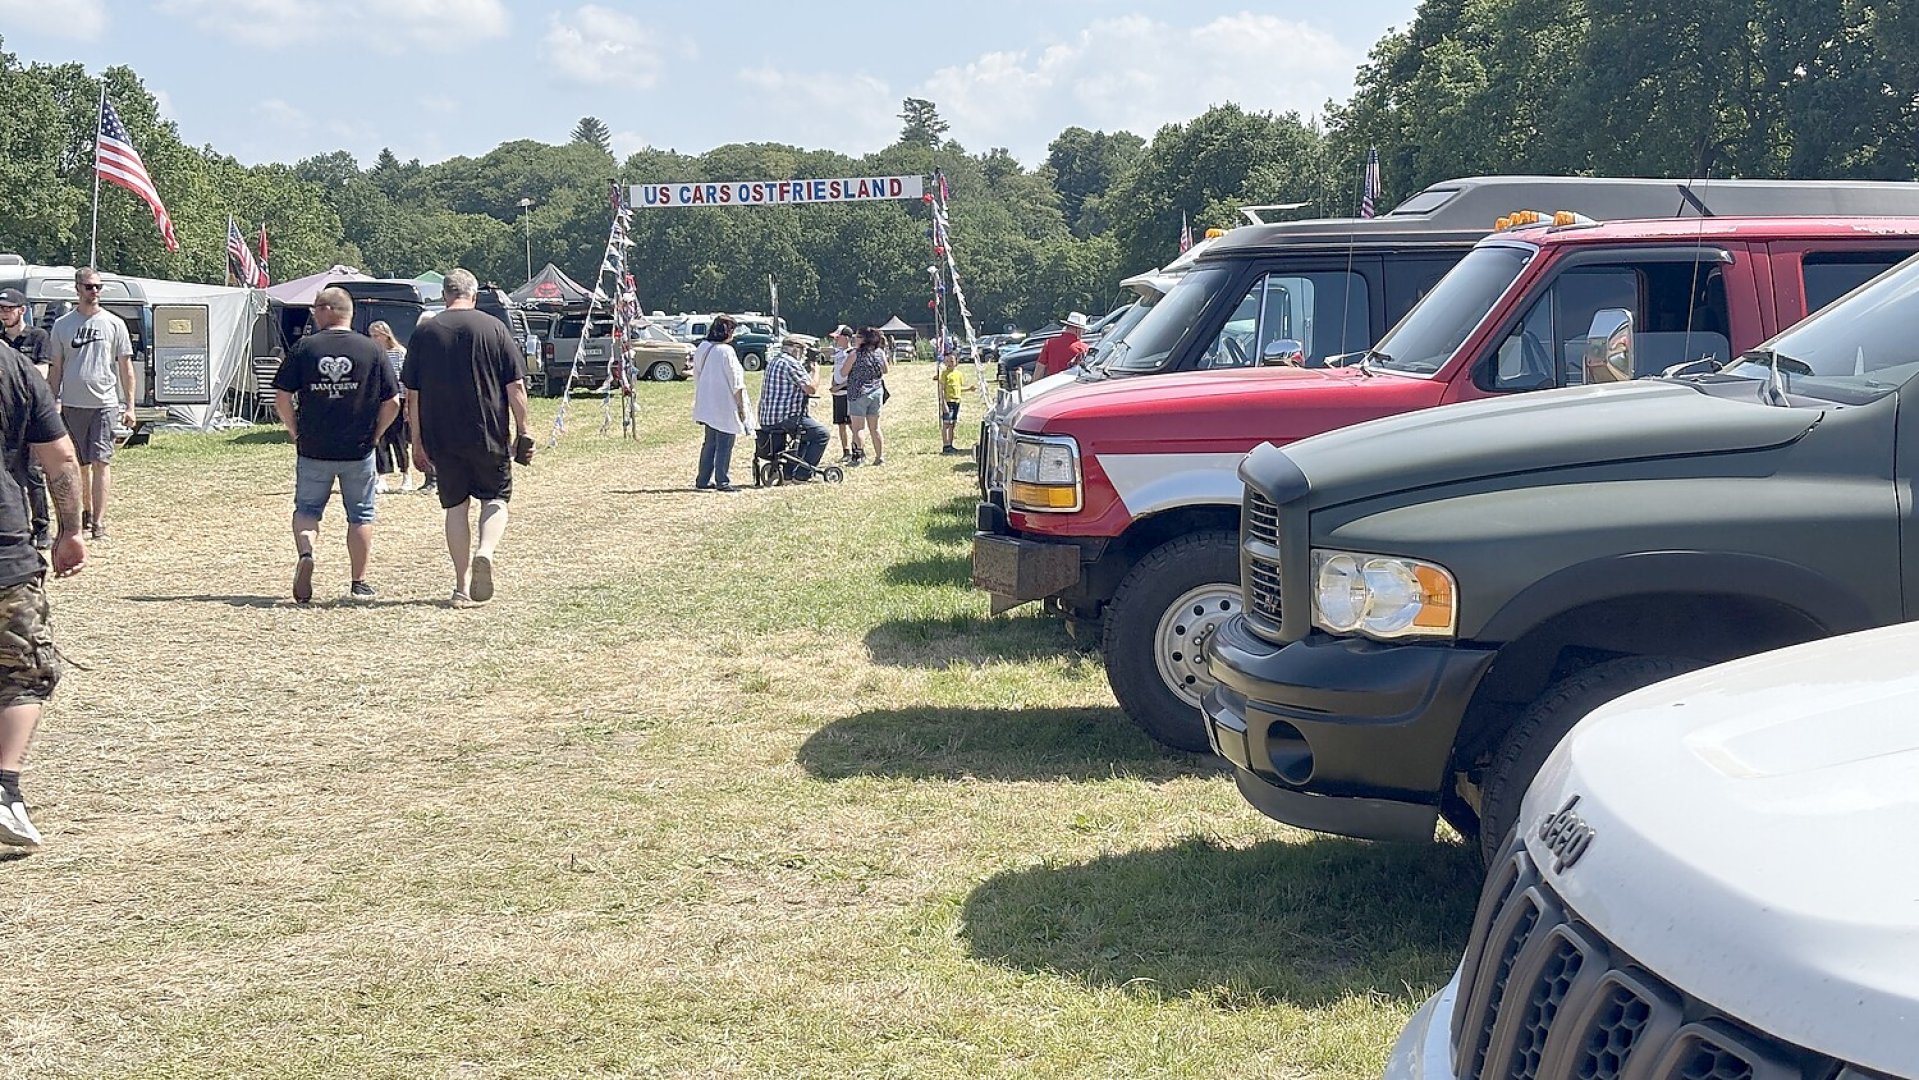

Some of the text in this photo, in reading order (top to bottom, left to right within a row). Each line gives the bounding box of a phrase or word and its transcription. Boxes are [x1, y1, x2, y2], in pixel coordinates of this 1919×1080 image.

[644, 178, 903, 204] US CARS OSTFRIESLAND
[333, 382, 358, 390] CREW
[1539, 795, 1594, 875] Jeep
